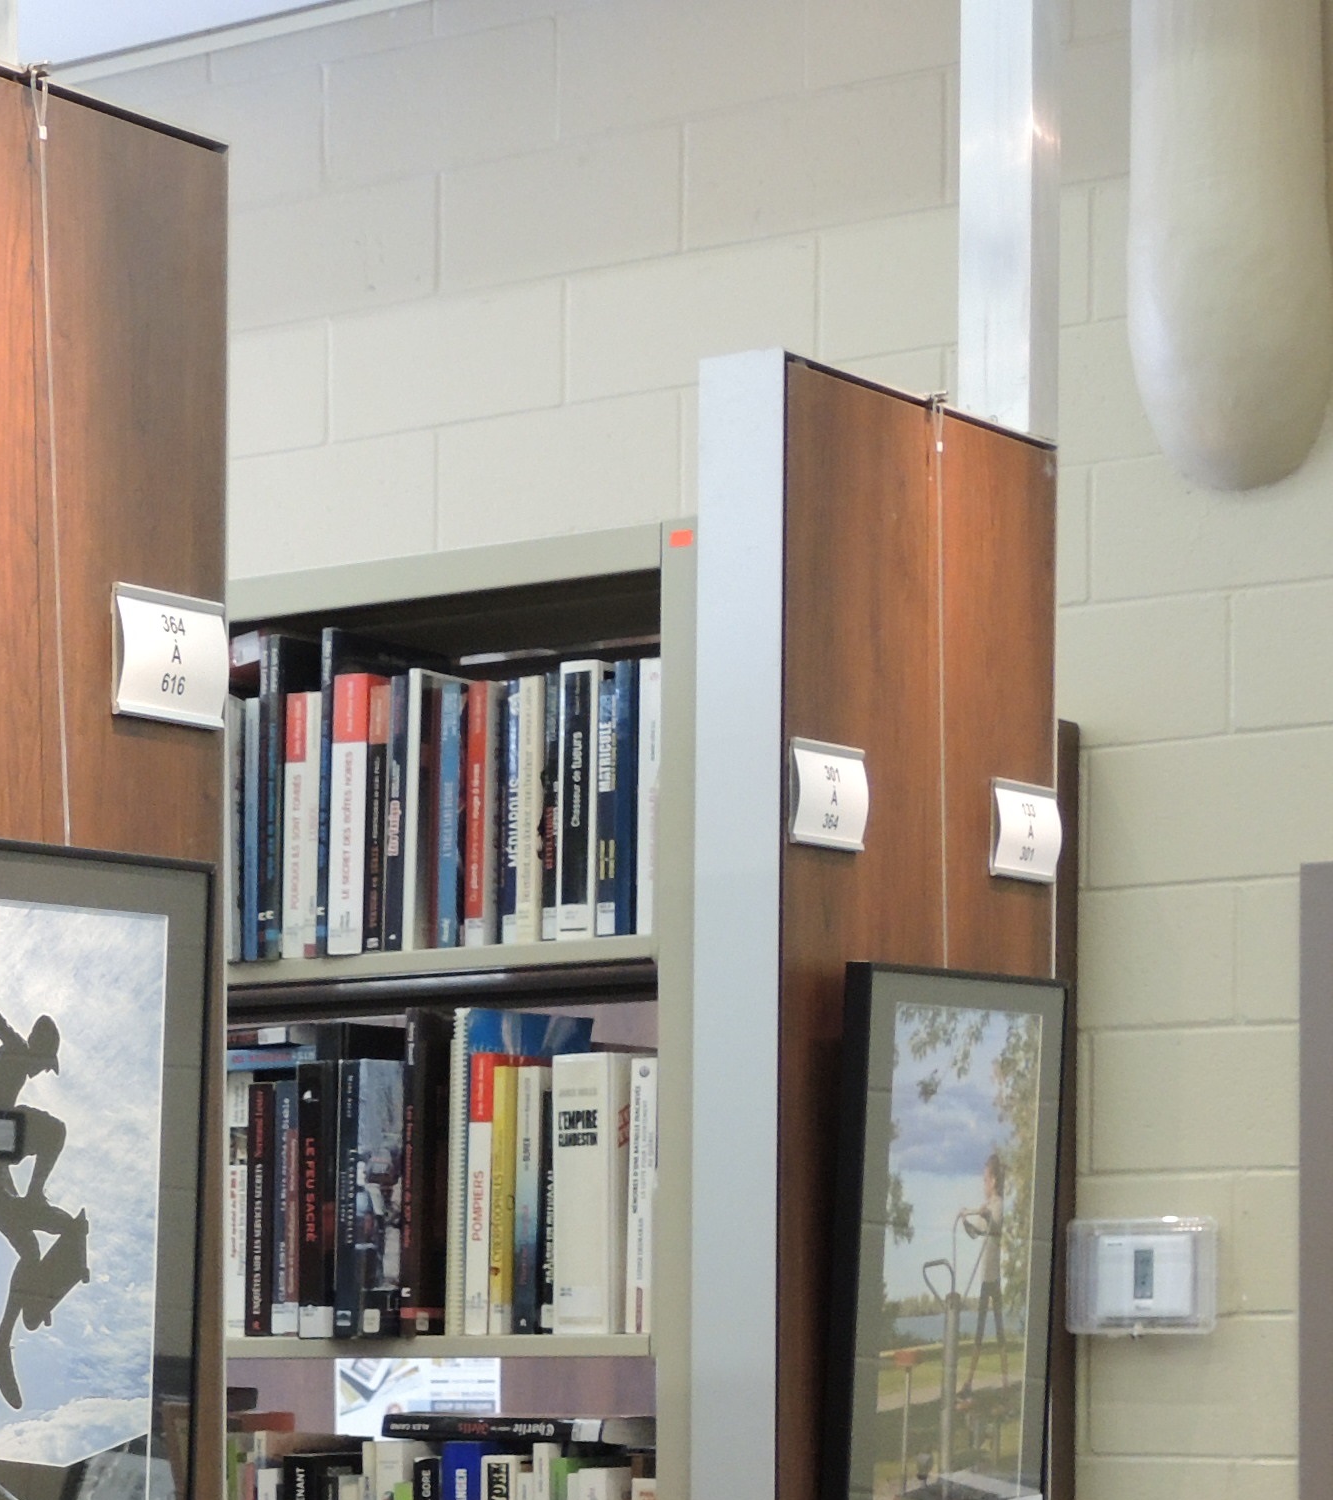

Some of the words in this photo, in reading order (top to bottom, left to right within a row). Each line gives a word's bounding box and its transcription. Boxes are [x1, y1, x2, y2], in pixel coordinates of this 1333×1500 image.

[161, 614, 186, 636] 364
[160, 672, 186, 696] 616
[598, 720, 612, 792] MATRICULE
[305, 1137, 315, 1155] LE
[305, 1160, 316, 1189] FEU
[305, 1194, 318, 1242] SACRÉ
[471, 1170, 484, 1241] POMPIERS
[422, 1470, 431, 1498] GORE
